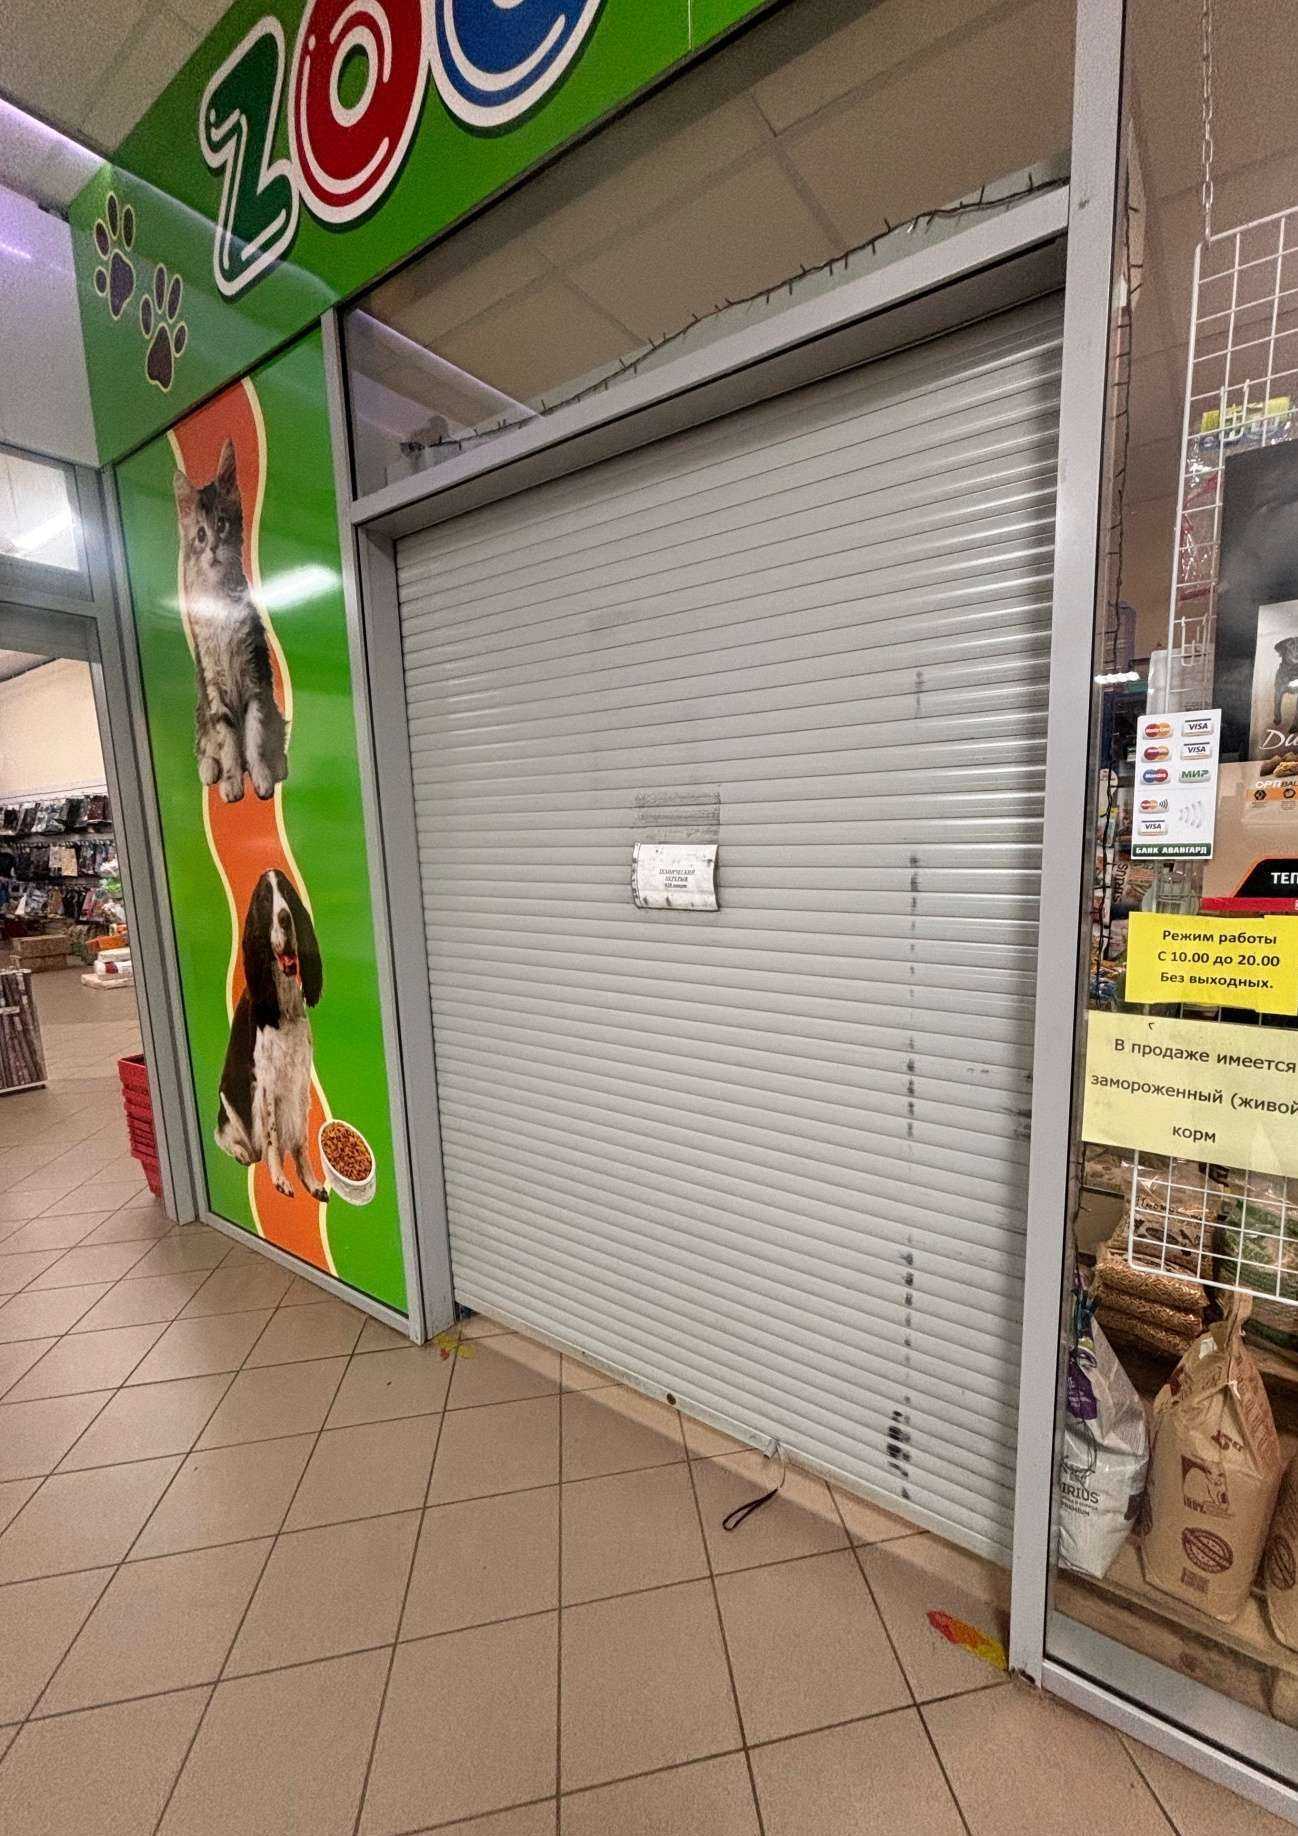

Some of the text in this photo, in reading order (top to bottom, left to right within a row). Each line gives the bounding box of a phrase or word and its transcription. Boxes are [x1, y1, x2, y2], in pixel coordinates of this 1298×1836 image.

[1189, 723, 1208, 731] VISA
[1187, 746, 1206, 754] VISA
[1181, 769, 1209, 779] МИР
[1136, 846, 1207, 854] БАНК АВАНГАРД
[1163, 930, 1277, 946] Режим работы
[1157, 950, 1281, 967] С 10.00 до 20.00
[1160, 971, 1274, 989] Без выходных.
[1114, 1038, 1297, 1074] В продаже имеется
[1090, 1074, 1224, 1105] замороженный
[1172, 1125, 1216, 1144] корм
[1059, 1482, 1099, 1505] IRIUS
